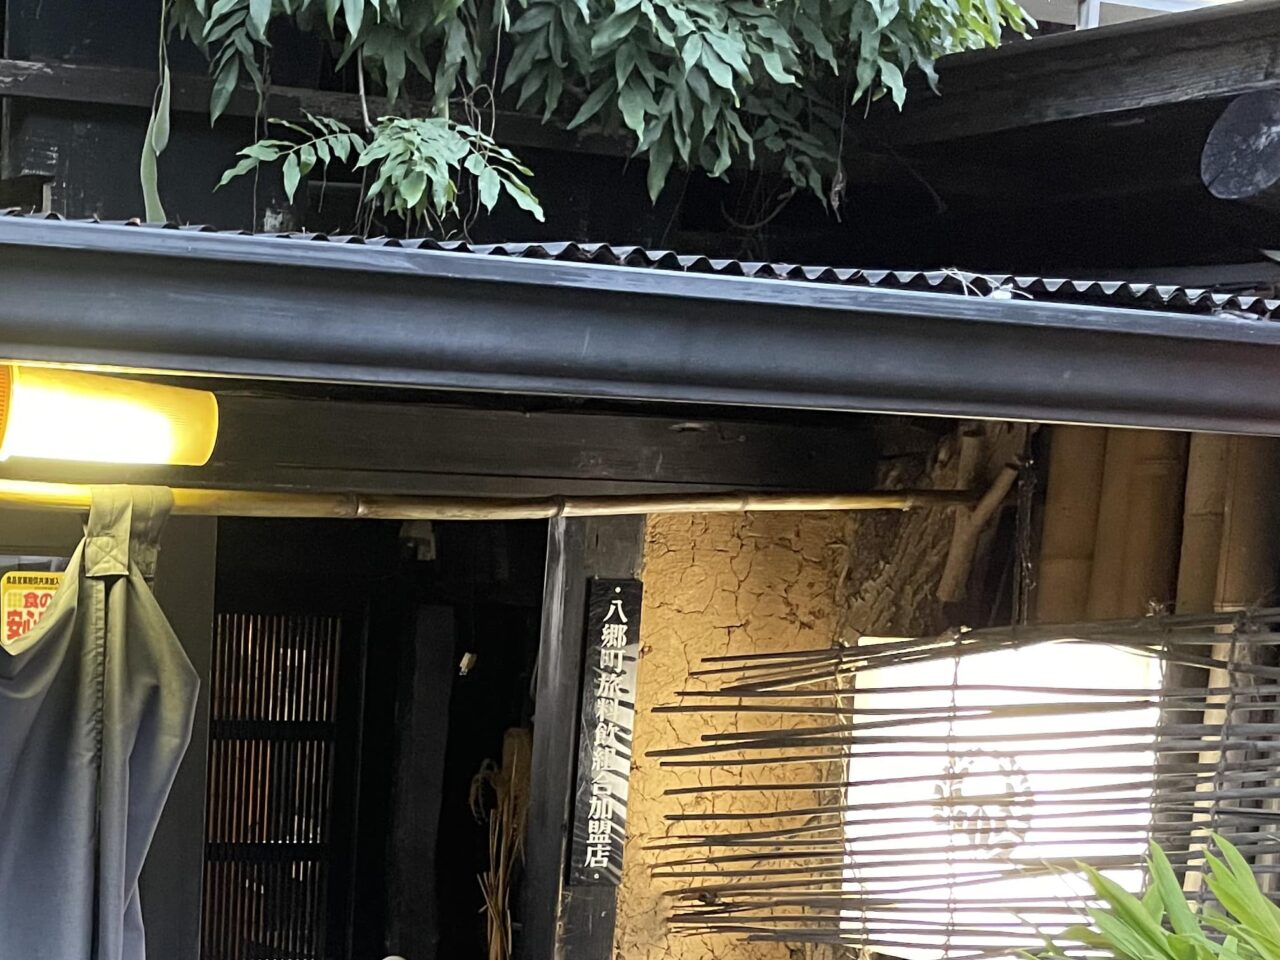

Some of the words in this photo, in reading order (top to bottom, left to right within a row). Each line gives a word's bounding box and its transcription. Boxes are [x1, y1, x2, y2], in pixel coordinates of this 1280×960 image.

[584, 599, 629, 870] 八郷町旅料飲組合加盟店
